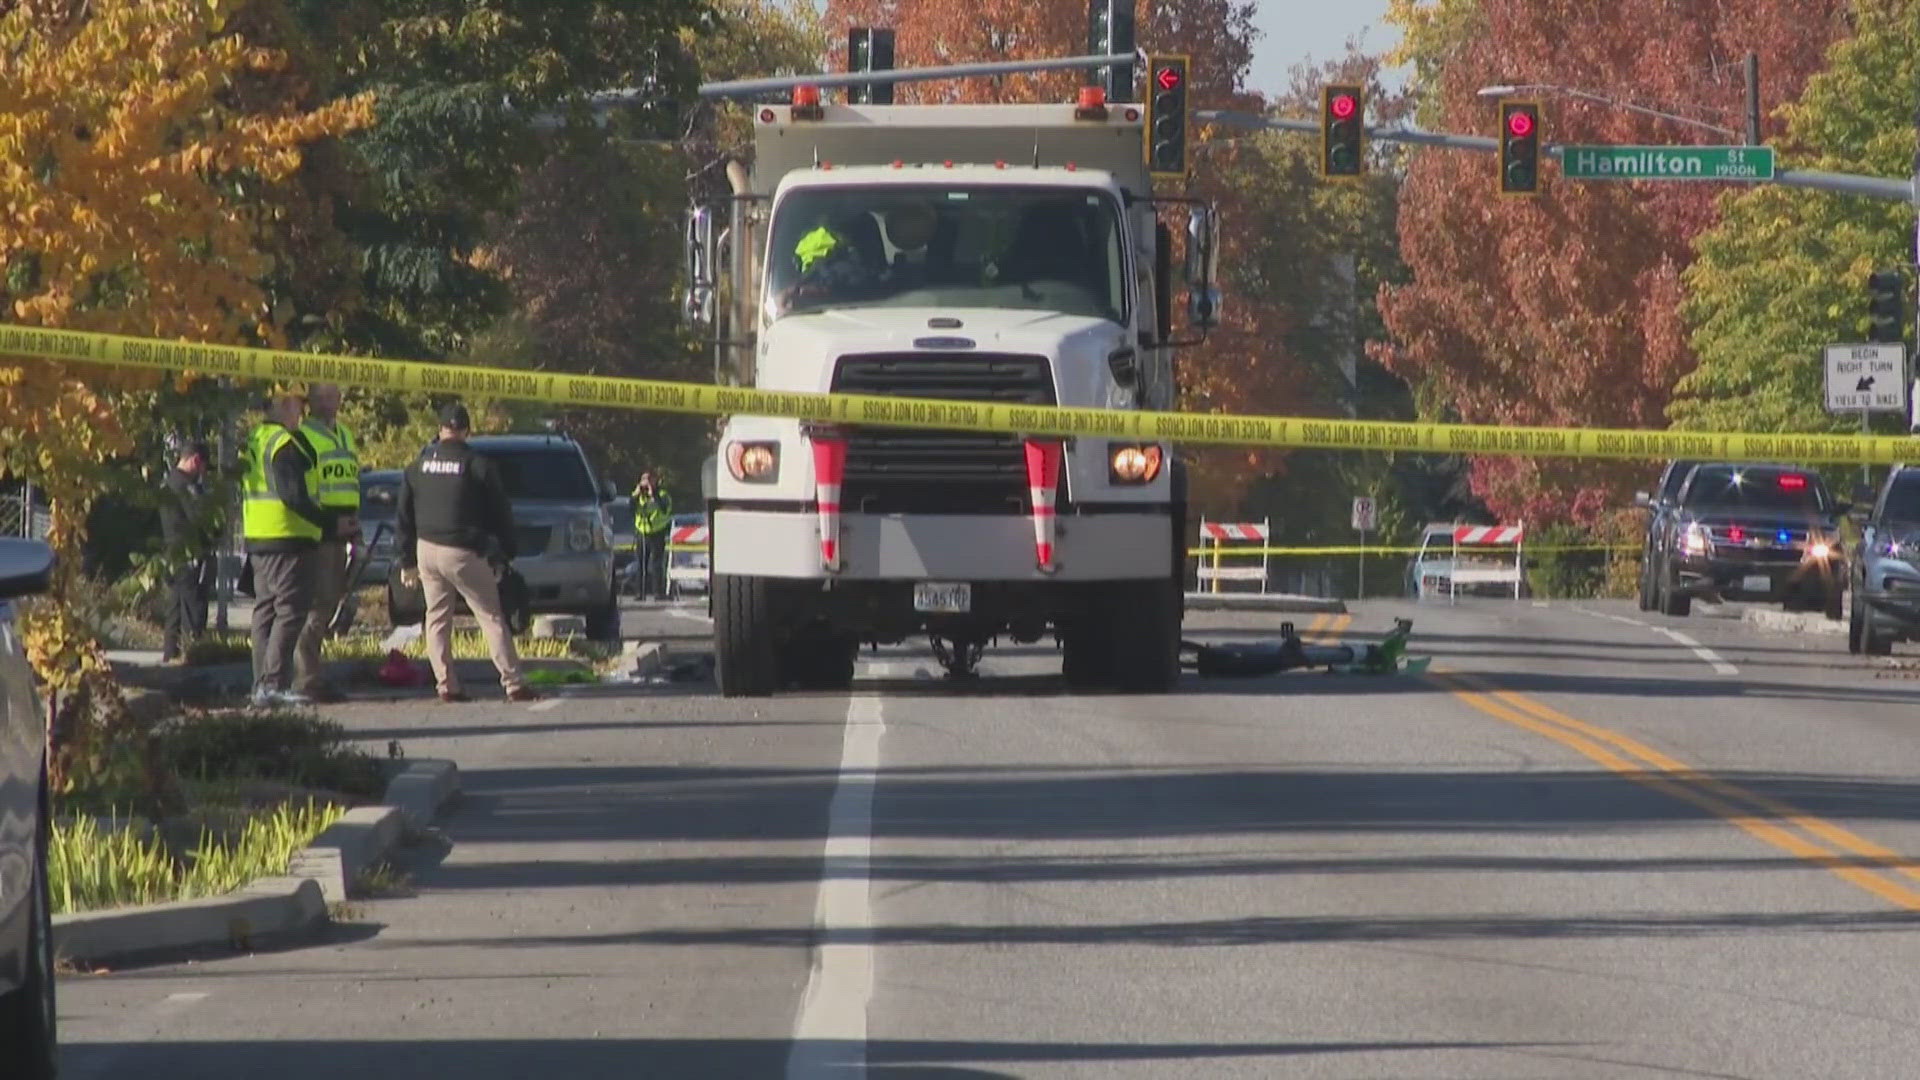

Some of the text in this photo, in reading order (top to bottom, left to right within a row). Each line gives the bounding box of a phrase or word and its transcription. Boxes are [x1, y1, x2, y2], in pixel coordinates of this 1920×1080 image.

[1577, 149, 1744, 174] Hamilton St
[1716, 164, 1756, 176] 1900N
[5, 328, 90, 357] POLICE LINE DO NOT
[122, 340, 240, 371] POLICE LINE DO NOT CROSS
[1870, 361, 1893, 372] TURN
[272, 354, 390, 384] POLICE LINE DO NOT CROSS
[421, 367, 538, 395] POLICE LINE DO NOT CROSS
[568, 379, 685, 406] POLICE LINE DO NOT CROSS
[716, 390, 831, 416] POLICE LINE DO NOT CROSS
[862, 400, 978, 425] POLICE LINE DO NOT CROSS
[1009, 408, 1125, 433] POLICE LINE DO NOT CROSS
[1156, 416, 1272, 440] POLICE LINE DO NOT CROSS
[1302, 423, 1418, 446] POLICE LINE DO NOT CROSS
[1450, 429, 1565, 451] POLICE LINE DO NOT CROSS
[1596, 433, 1712, 455] POLICE LINE DO NOT CROSS
[1744, 437, 1860, 458] POLICE LINE DO NOT CROSS
[422, 460, 460, 474] POLICE
